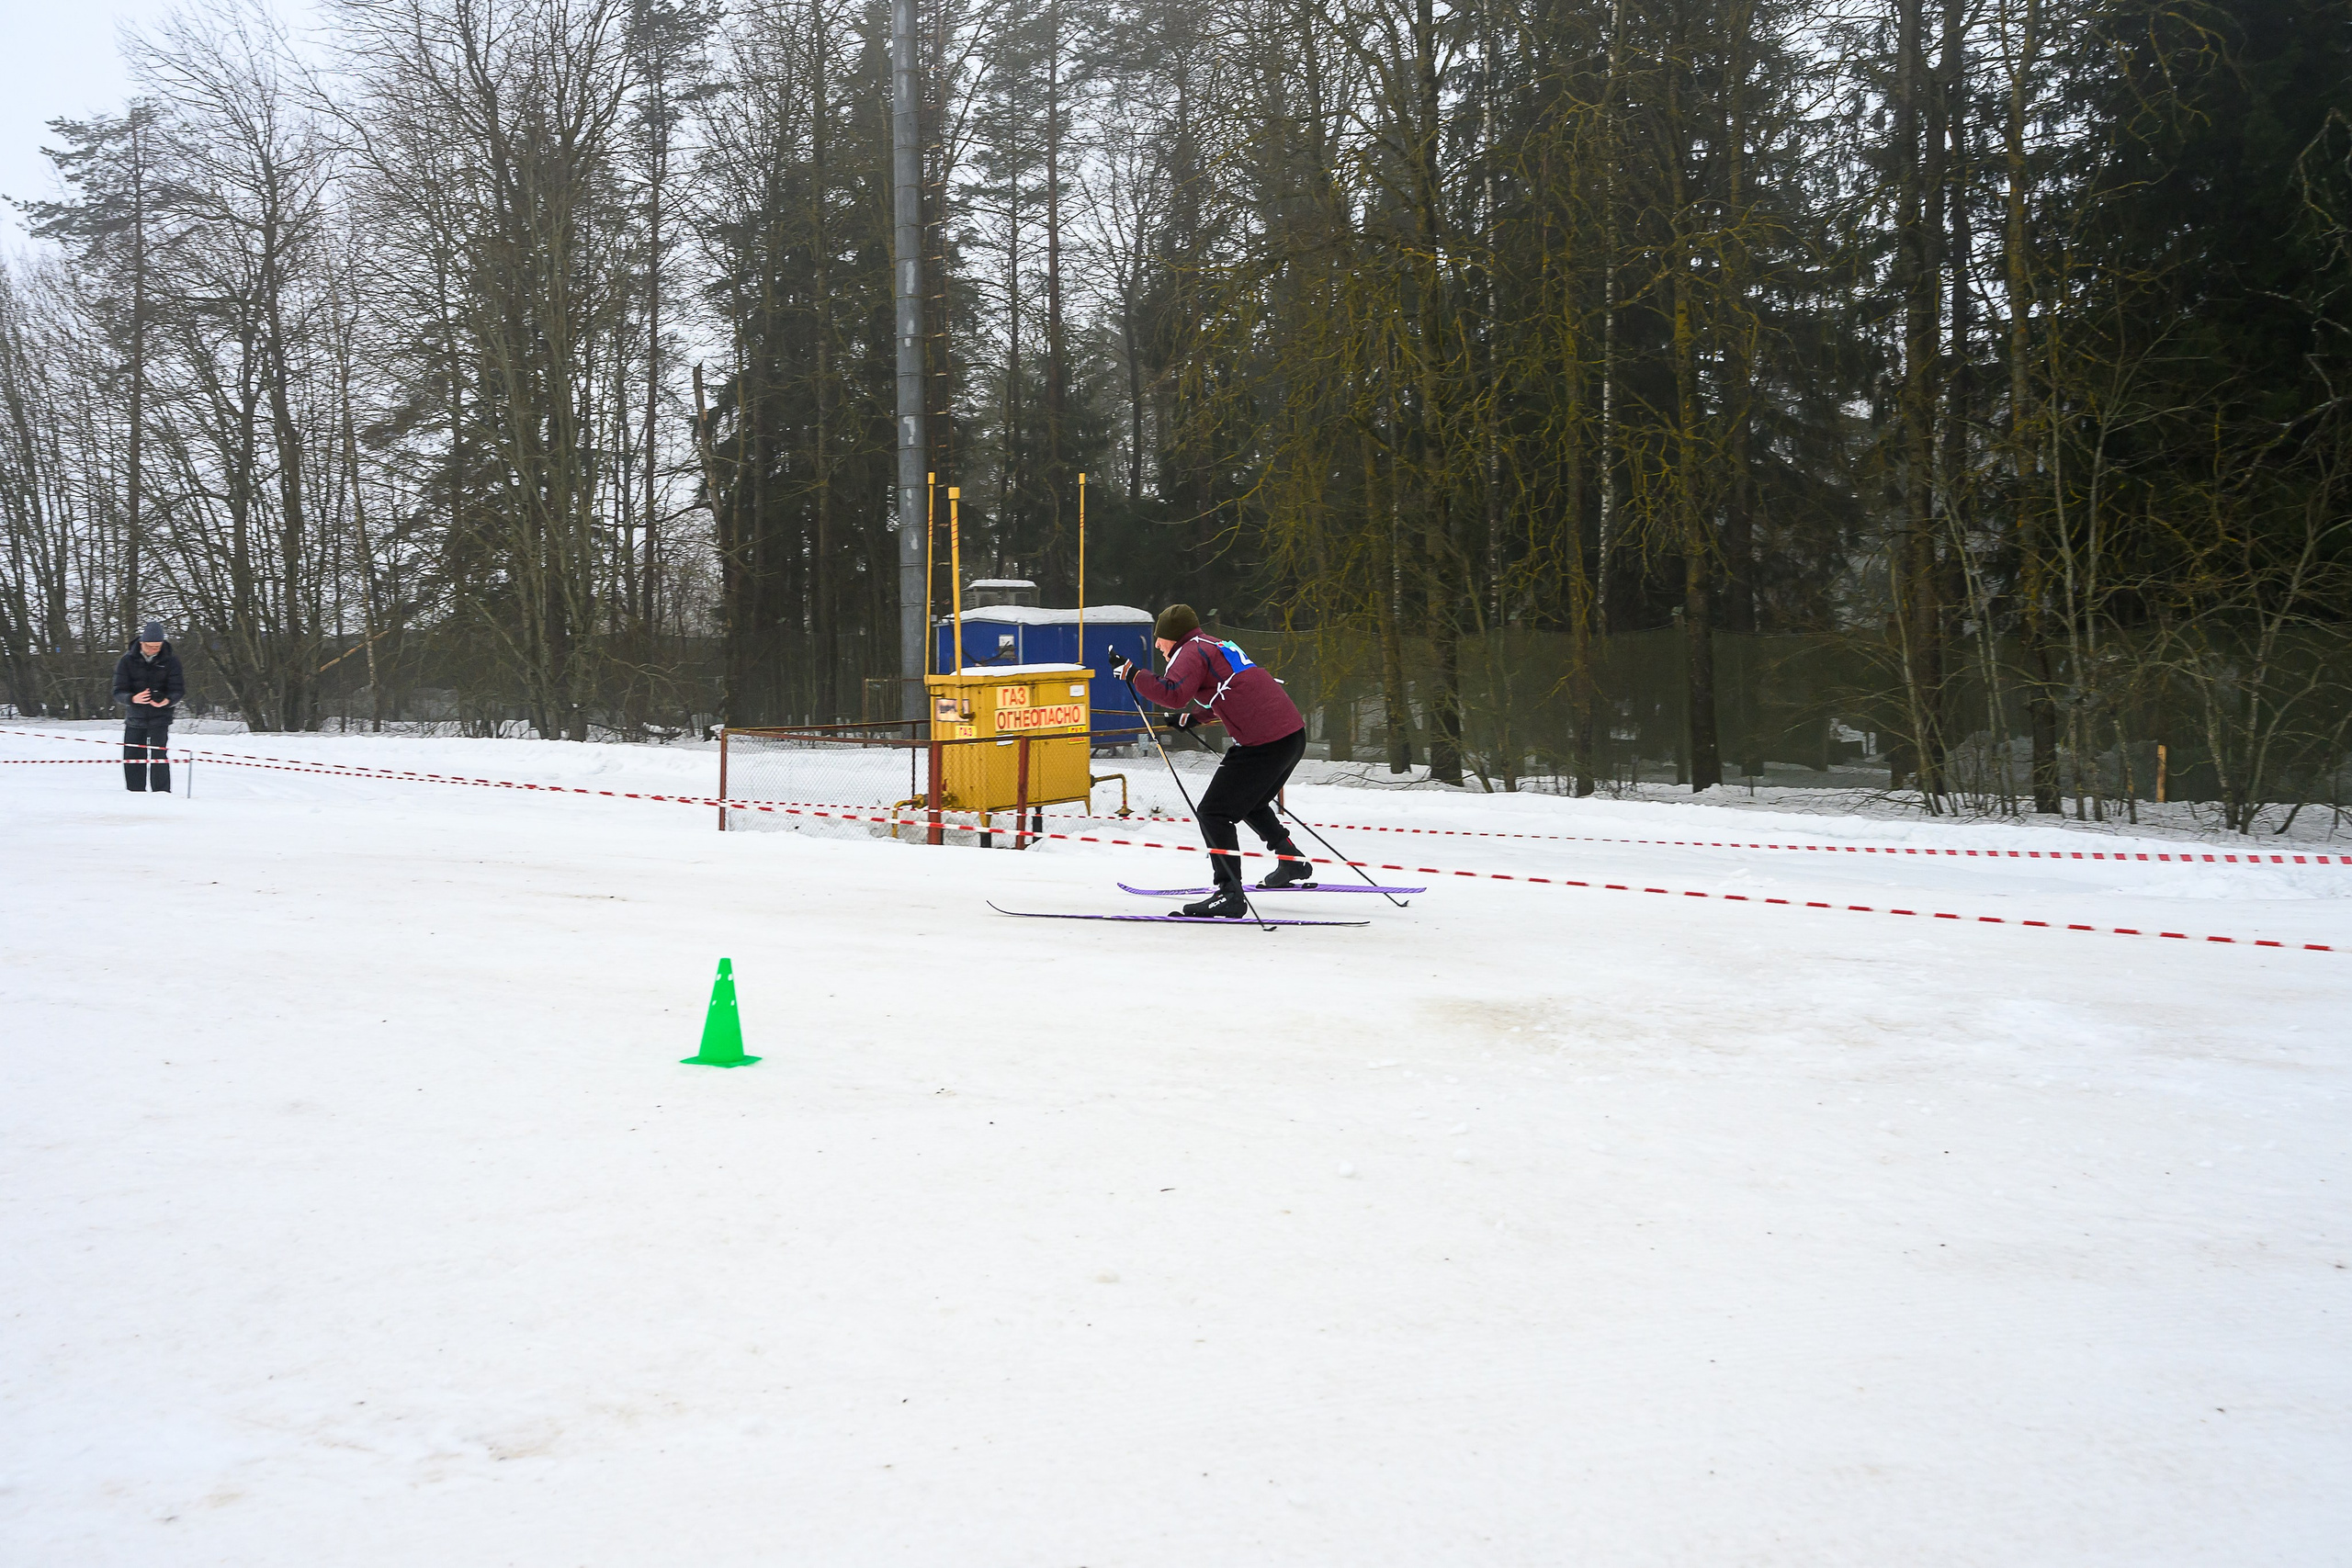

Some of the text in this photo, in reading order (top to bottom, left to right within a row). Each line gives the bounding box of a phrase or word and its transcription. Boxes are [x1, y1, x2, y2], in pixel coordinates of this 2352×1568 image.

[1001, 686, 1026, 706] ГАЗ
[997, 705, 1080, 729] ОГНЕОПАСНО
[958, 727, 973, 737] ГАЗ
